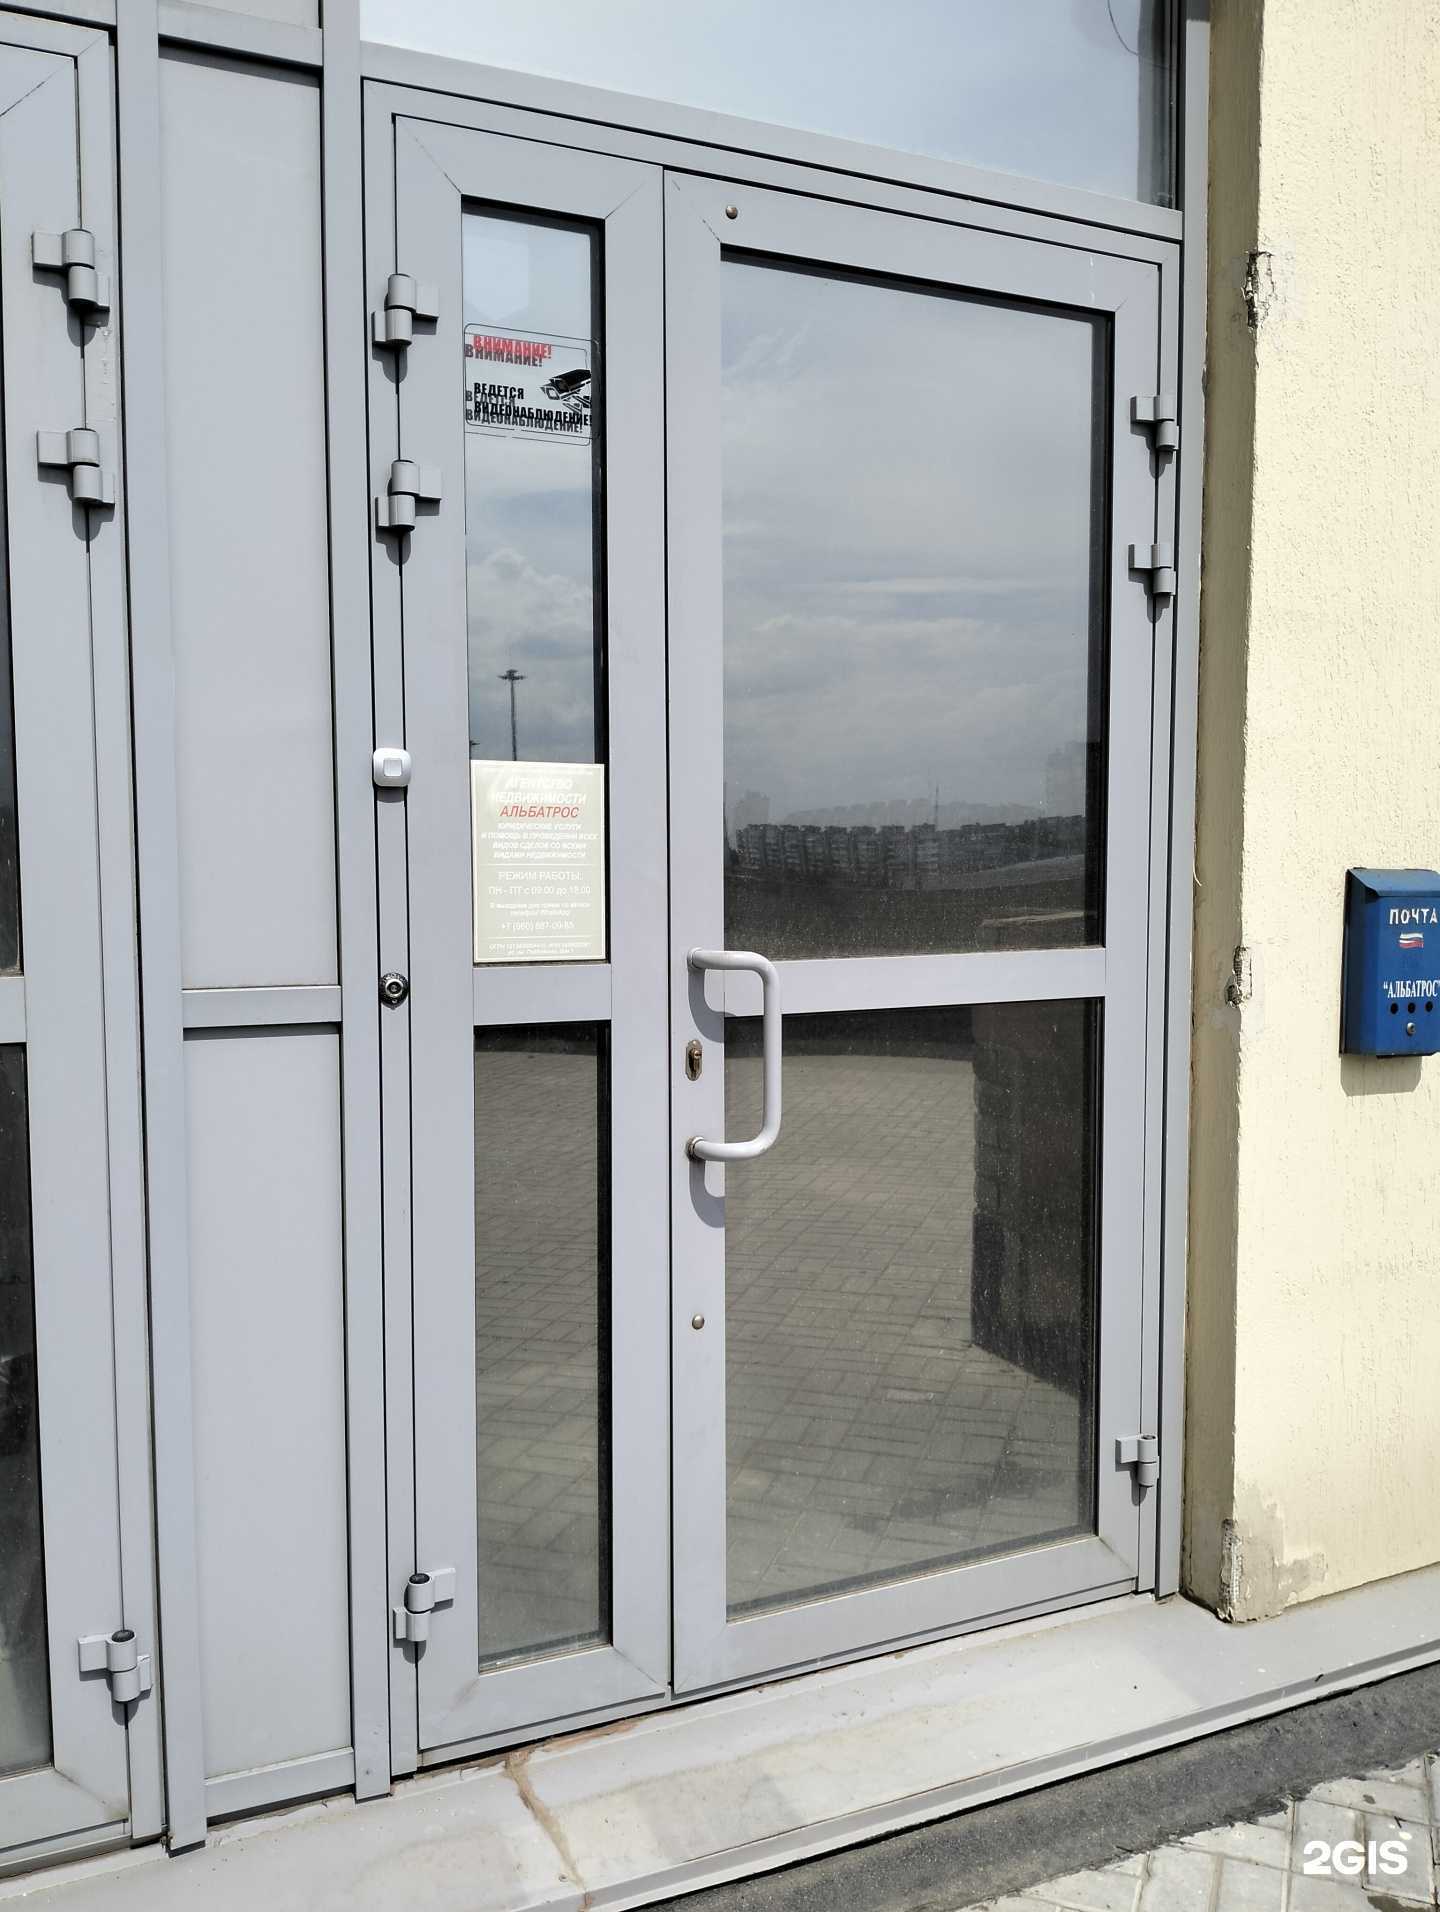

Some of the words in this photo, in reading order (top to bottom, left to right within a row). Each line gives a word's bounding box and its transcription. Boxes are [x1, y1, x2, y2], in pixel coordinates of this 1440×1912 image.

[473, 336, 552, 359] ВНИМАНИЕ!
[474, 382, 524, 399] ВЕДЕТСЯ
[500, 805, 580, 818] АЛЬБАТРОС
[498, 872, 537, 880] РЕЖИМ
[1389, 908, 1438, 925] ПОЧТА
